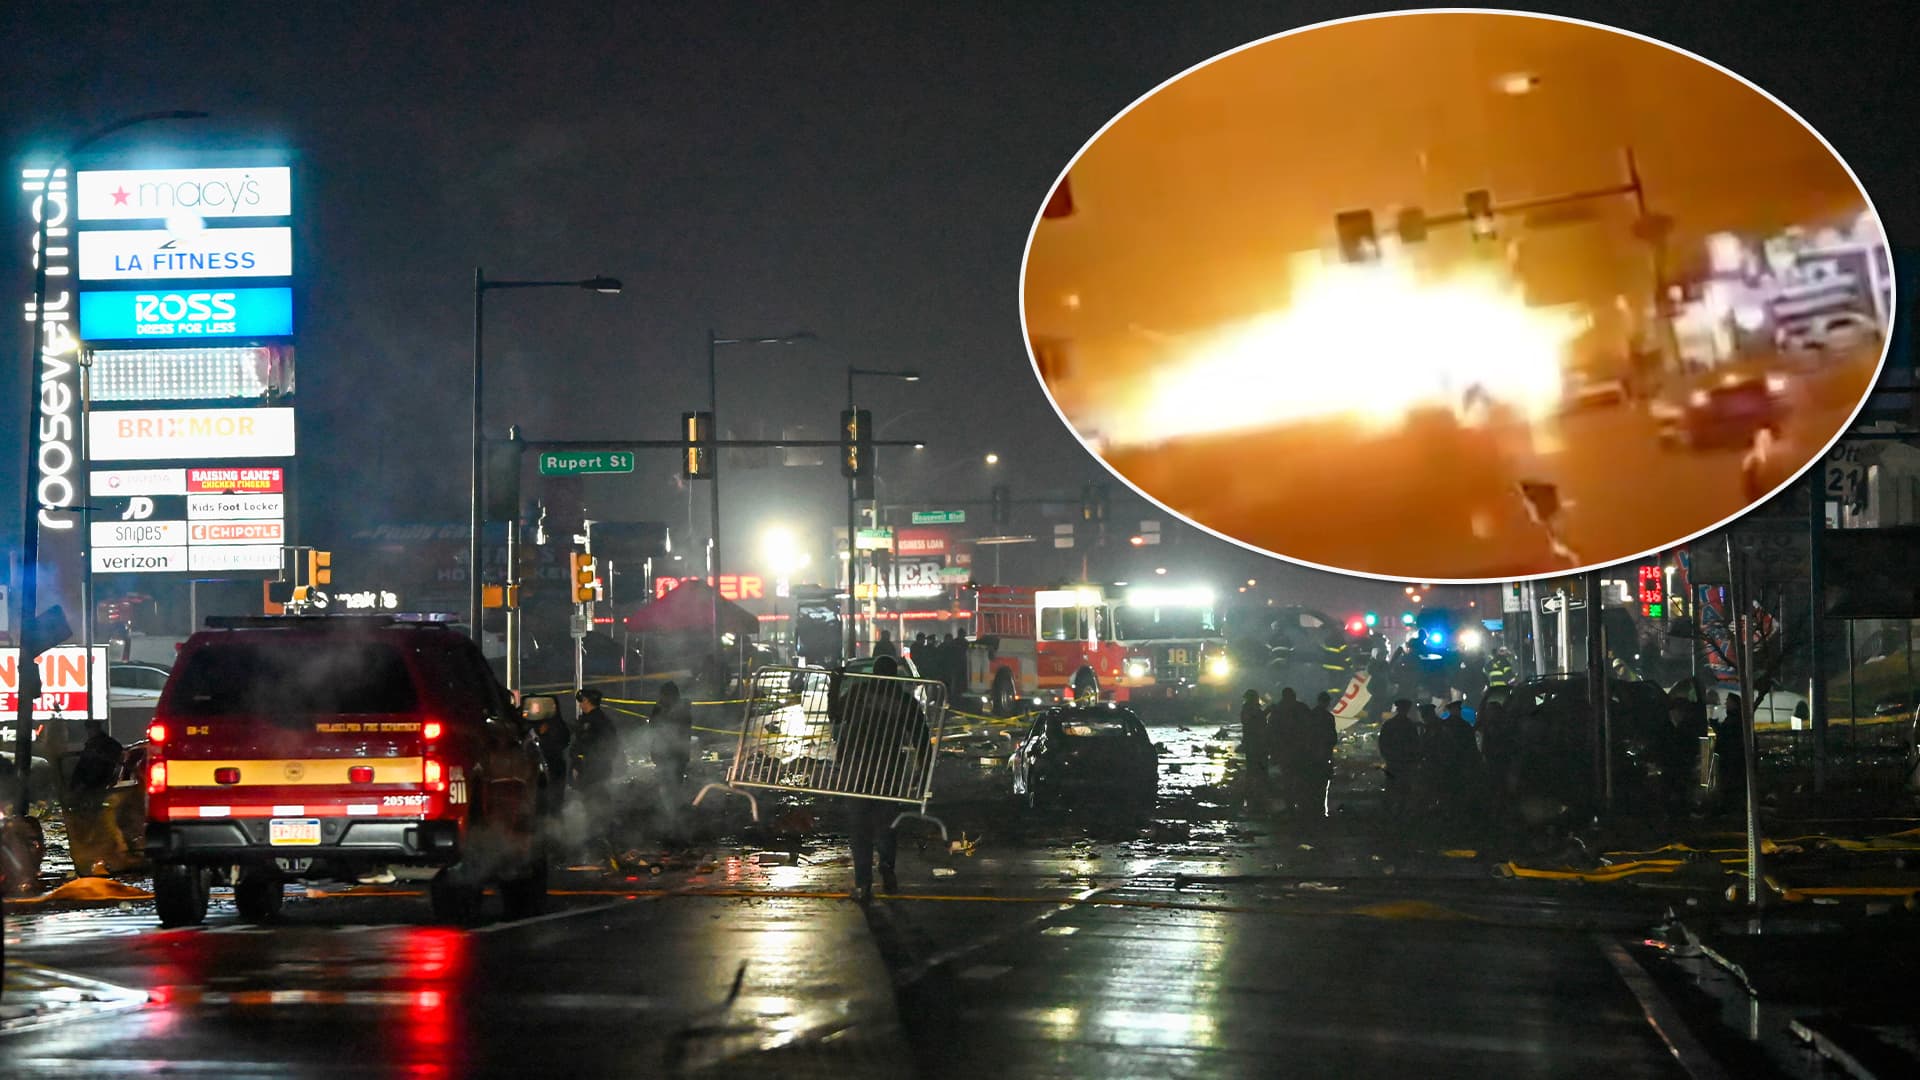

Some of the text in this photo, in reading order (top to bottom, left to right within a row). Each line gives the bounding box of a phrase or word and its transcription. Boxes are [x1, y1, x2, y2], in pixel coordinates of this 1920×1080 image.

[138, 173, 261, 213] macy's
[114, 251, 256, 272] LA FITNESS
[135, 293, 236, 322] ROSS
[136, 322, 236, 335] DRESS FOR LESS
[22, 168, 74, 529] roosevelt mall
[117, 416, 256, 439] BRIXMOR
[547, 455, 627, 471] Rupert St
[191, 470, 280, 481] RAISING CANE'S
[201, 480, 271, 489] CHICKEN FINGERS
[121, 496, 154, 520] JD
[192, 502, 279, 512] Kids Foot Locker
[115, 526, 162, 544] snipes
[210, 526, 279, 538] CHIPOTLE
[102, 553, 168, 569] verizon
[1168, 648, 1187, 664] 18
[449, 782, 467, 804] 911
